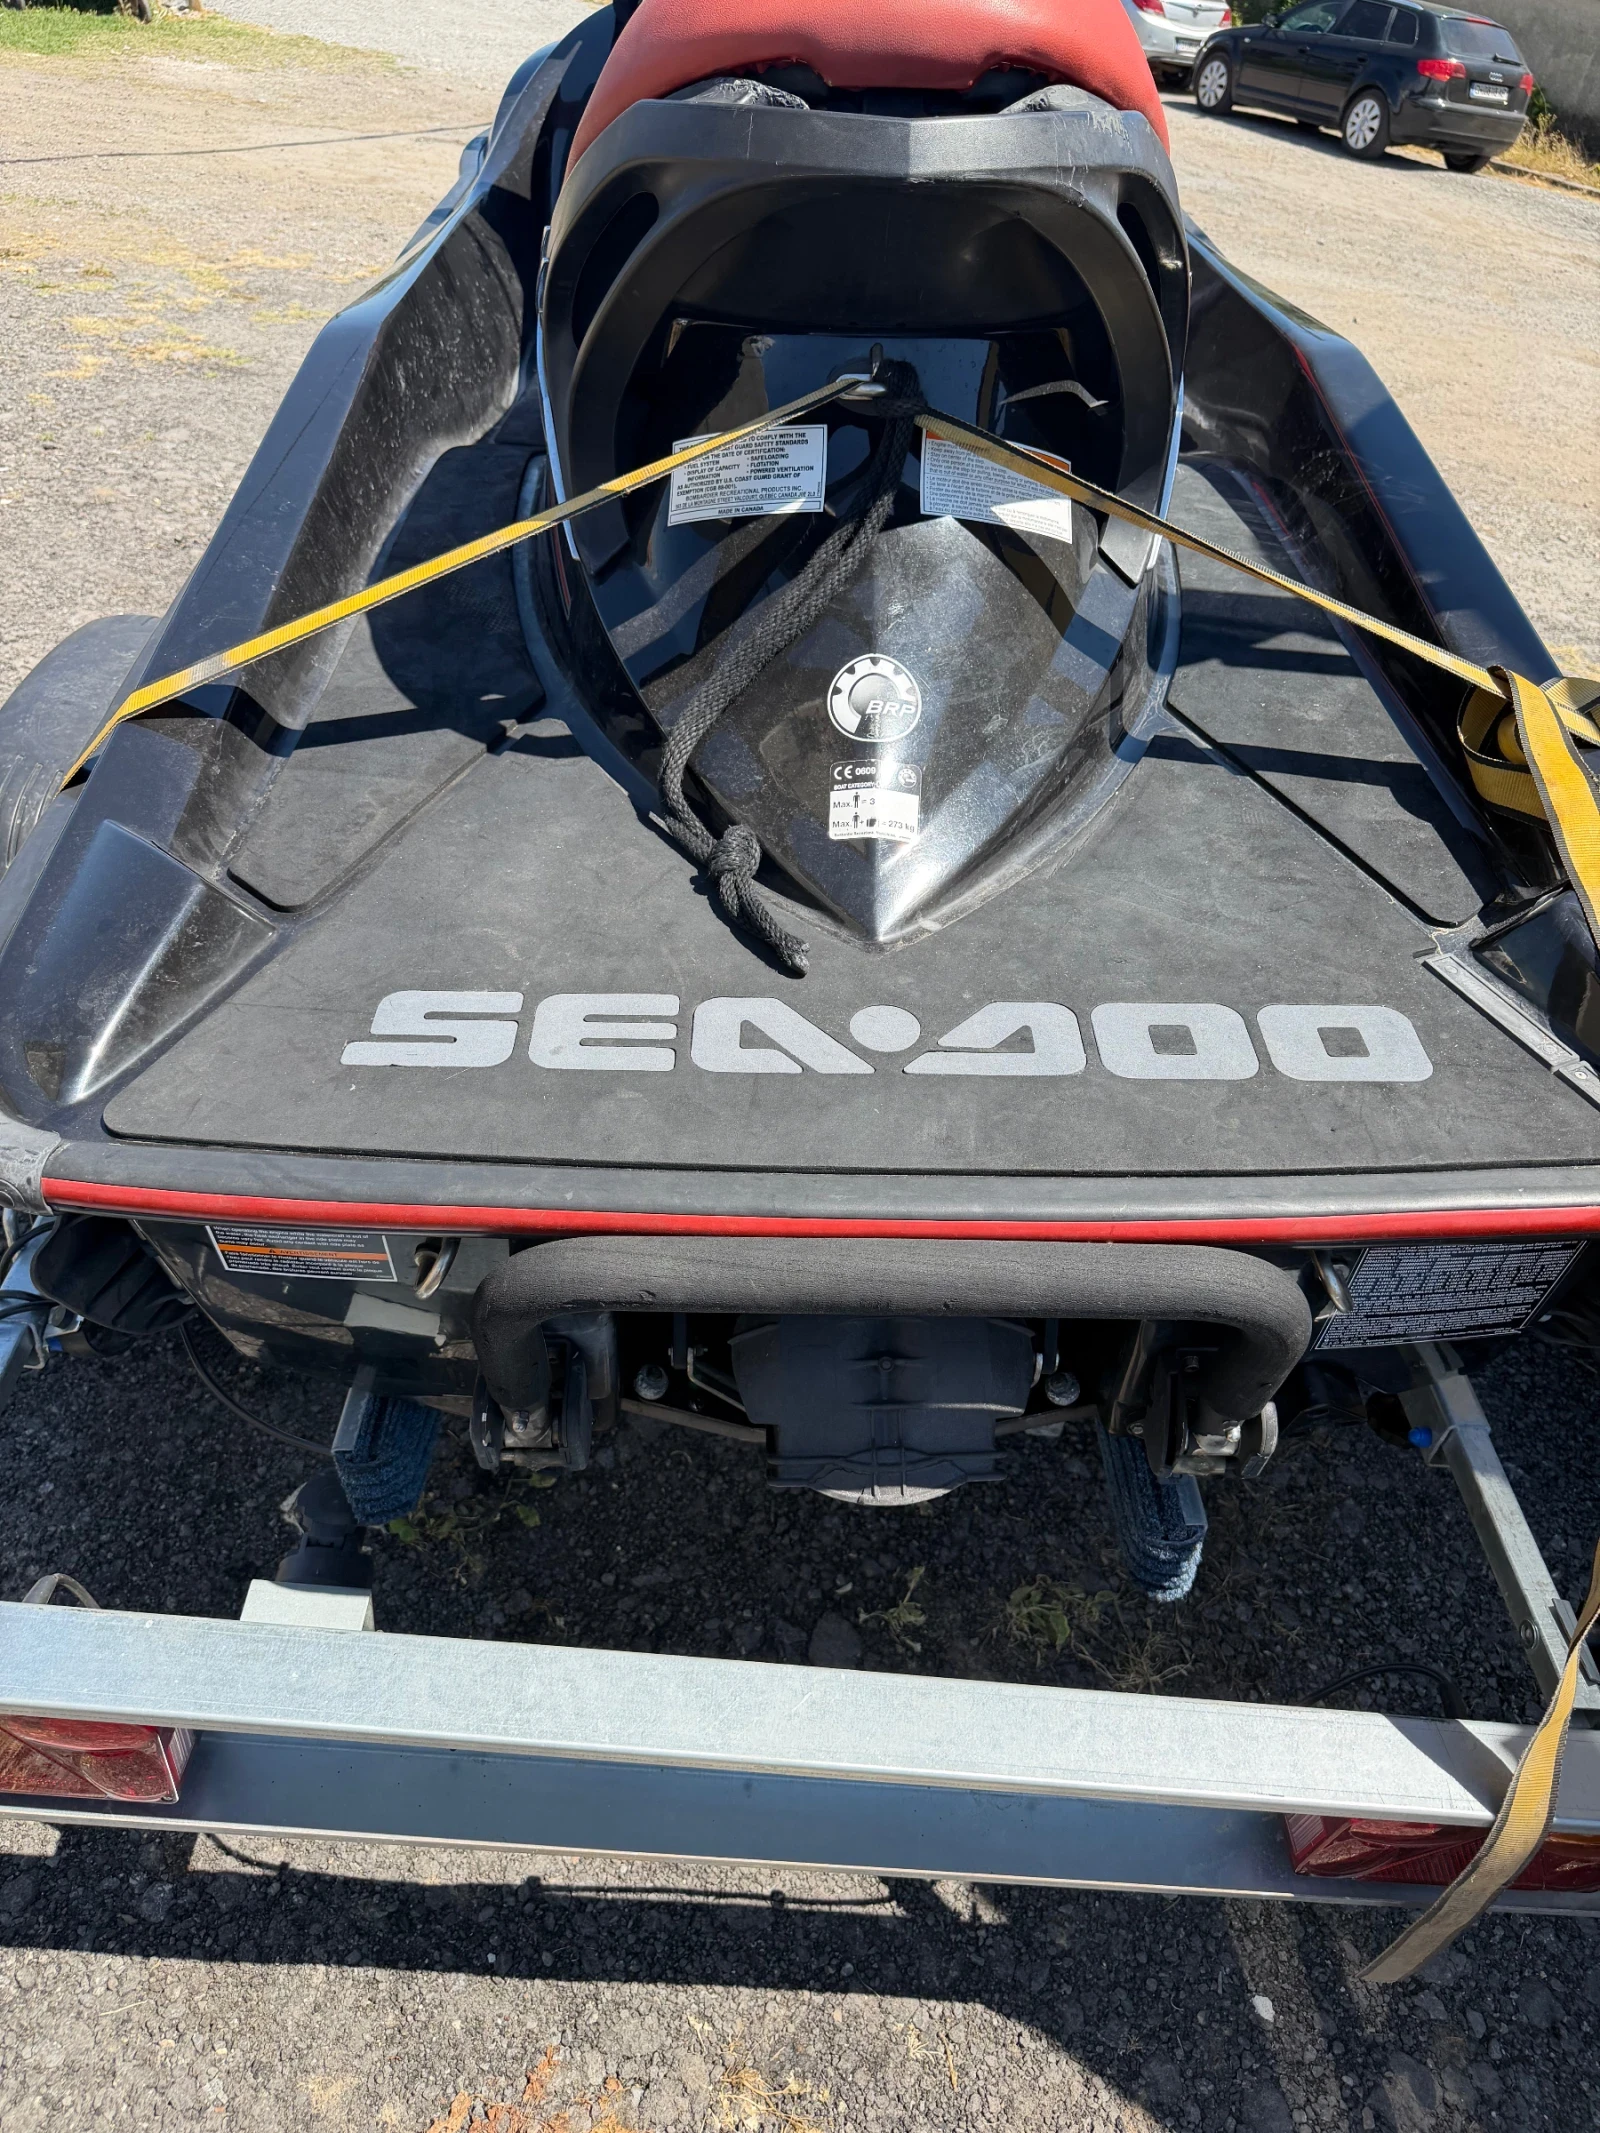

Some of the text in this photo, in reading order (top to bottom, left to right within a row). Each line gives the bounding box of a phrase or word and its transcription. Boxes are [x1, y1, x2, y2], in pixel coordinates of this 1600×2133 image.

[715, 464, 740, 472] CAPACITY
[687, 472, 720, 481] INFORMATION
[684, 479, 714, 488] AUTHORIZED
[676, 487, 703, 496] EXEMPTION
[686, 491, 718, 500] BOMBARDIER
[719, 487, 759, 496] RECREATIONAL
[866, 700, 916, 717] BRP
[834, 765, 876, 780] CE 0609
[888, 820, 903, 830] 273
[906, 823, 915, 832] kg
